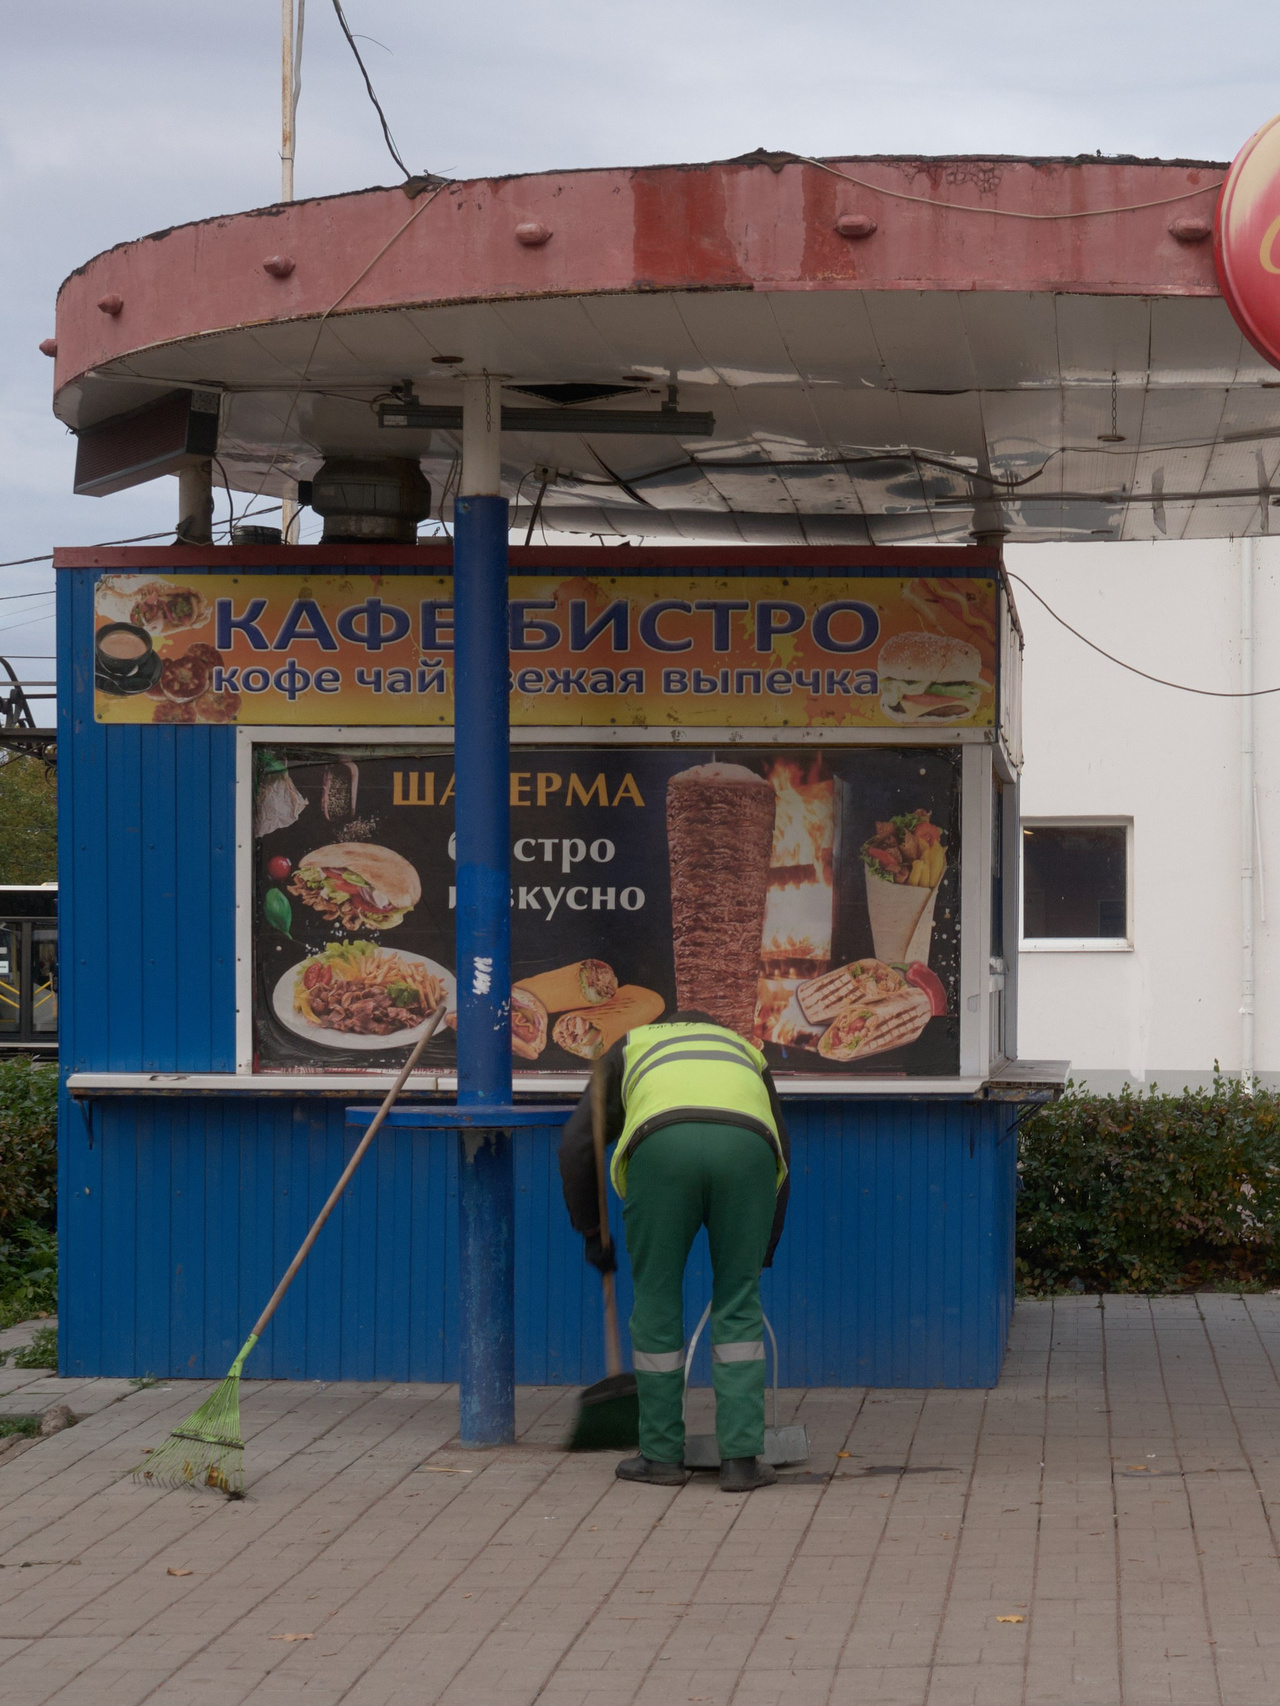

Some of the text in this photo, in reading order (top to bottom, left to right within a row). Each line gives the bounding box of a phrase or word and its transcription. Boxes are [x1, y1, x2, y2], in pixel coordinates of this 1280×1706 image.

[215, 597, 881, 655] КАФЕ БИСТРО
[212, 658, 881, 702] кофе чай ежая выпечка
[392, 771, 646, 807] ШАЕРМА
[447, 830, 616, 873] стро
